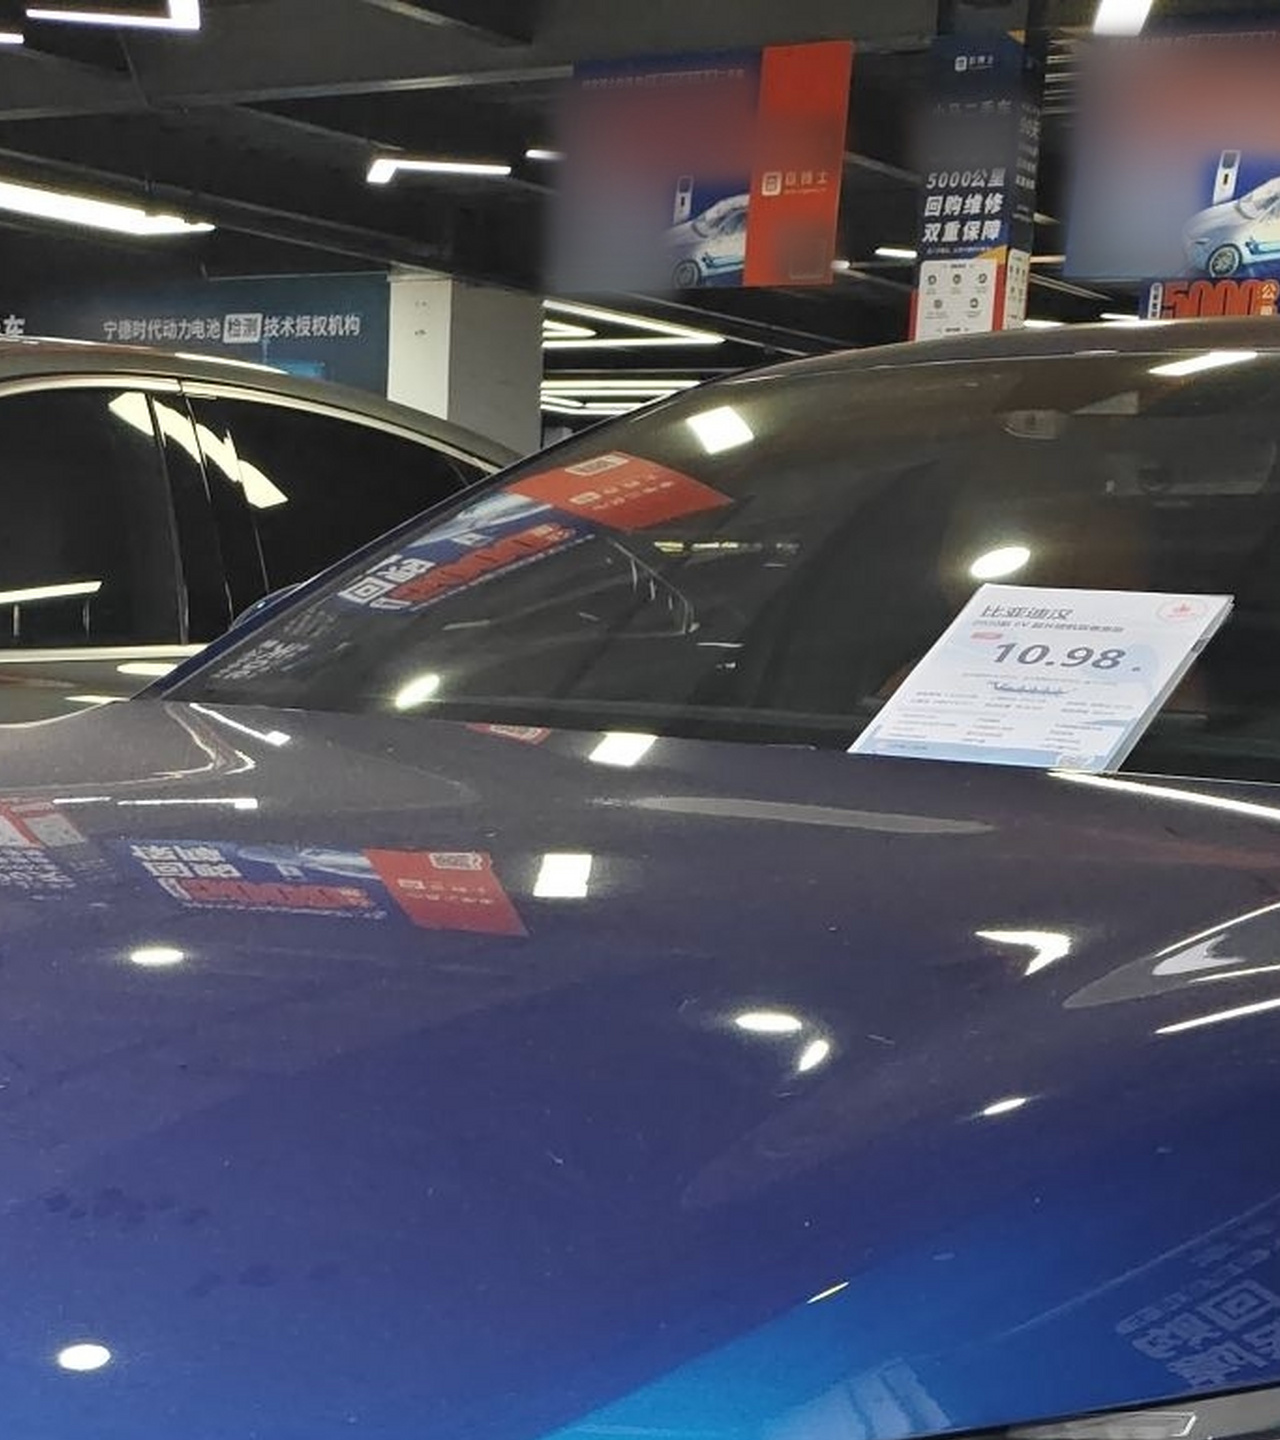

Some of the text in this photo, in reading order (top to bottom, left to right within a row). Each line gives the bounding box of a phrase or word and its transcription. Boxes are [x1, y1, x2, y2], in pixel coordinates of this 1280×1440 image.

[926, 168, 1006, 188] 5000公里
[924, 192, 1004, 217] 回购维修
[922, 219, 1002, 243] 双重保障
[993, 642, 1127, 669] 10.98
